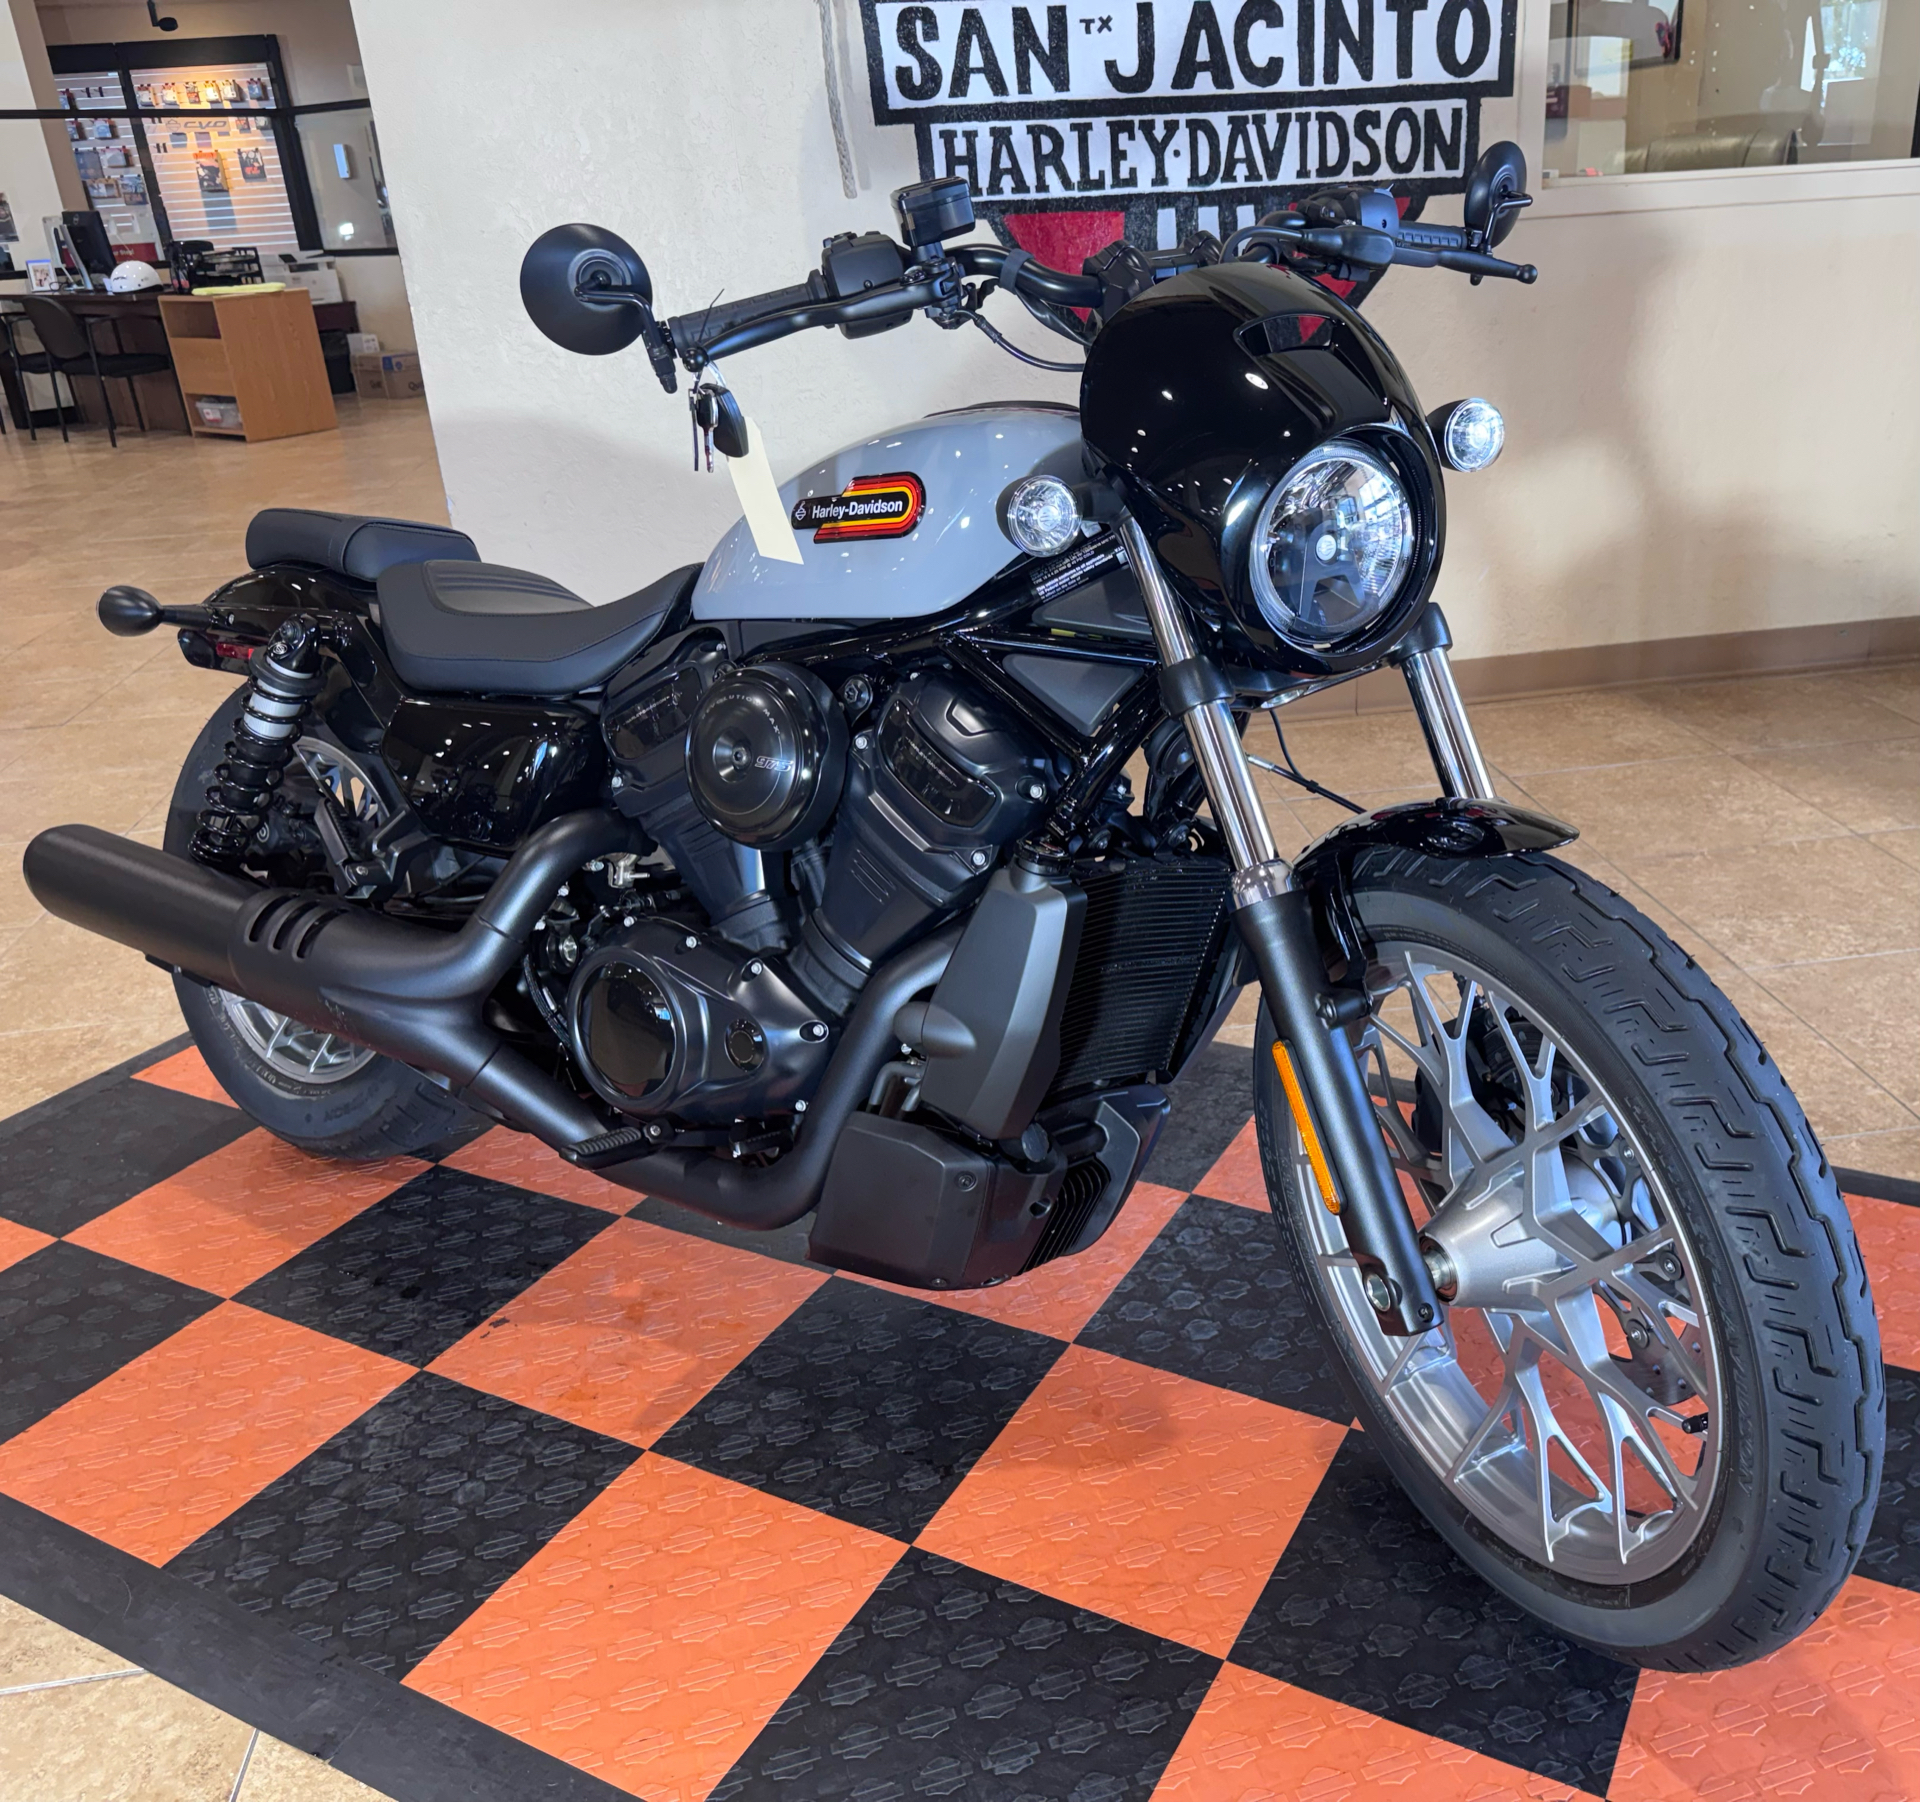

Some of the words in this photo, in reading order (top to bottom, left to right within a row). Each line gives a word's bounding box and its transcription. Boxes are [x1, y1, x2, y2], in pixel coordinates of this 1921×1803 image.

[895, 5, 1070, 101] SAN
[1080, 14, 1113, 35] TX
[1103, 0, 1491, 94] JACINTO
[184, 120, 227, 130] CVO
[811, 498, 903, 519] Harley-Davidson
[754, 755, 794, 772] 975
